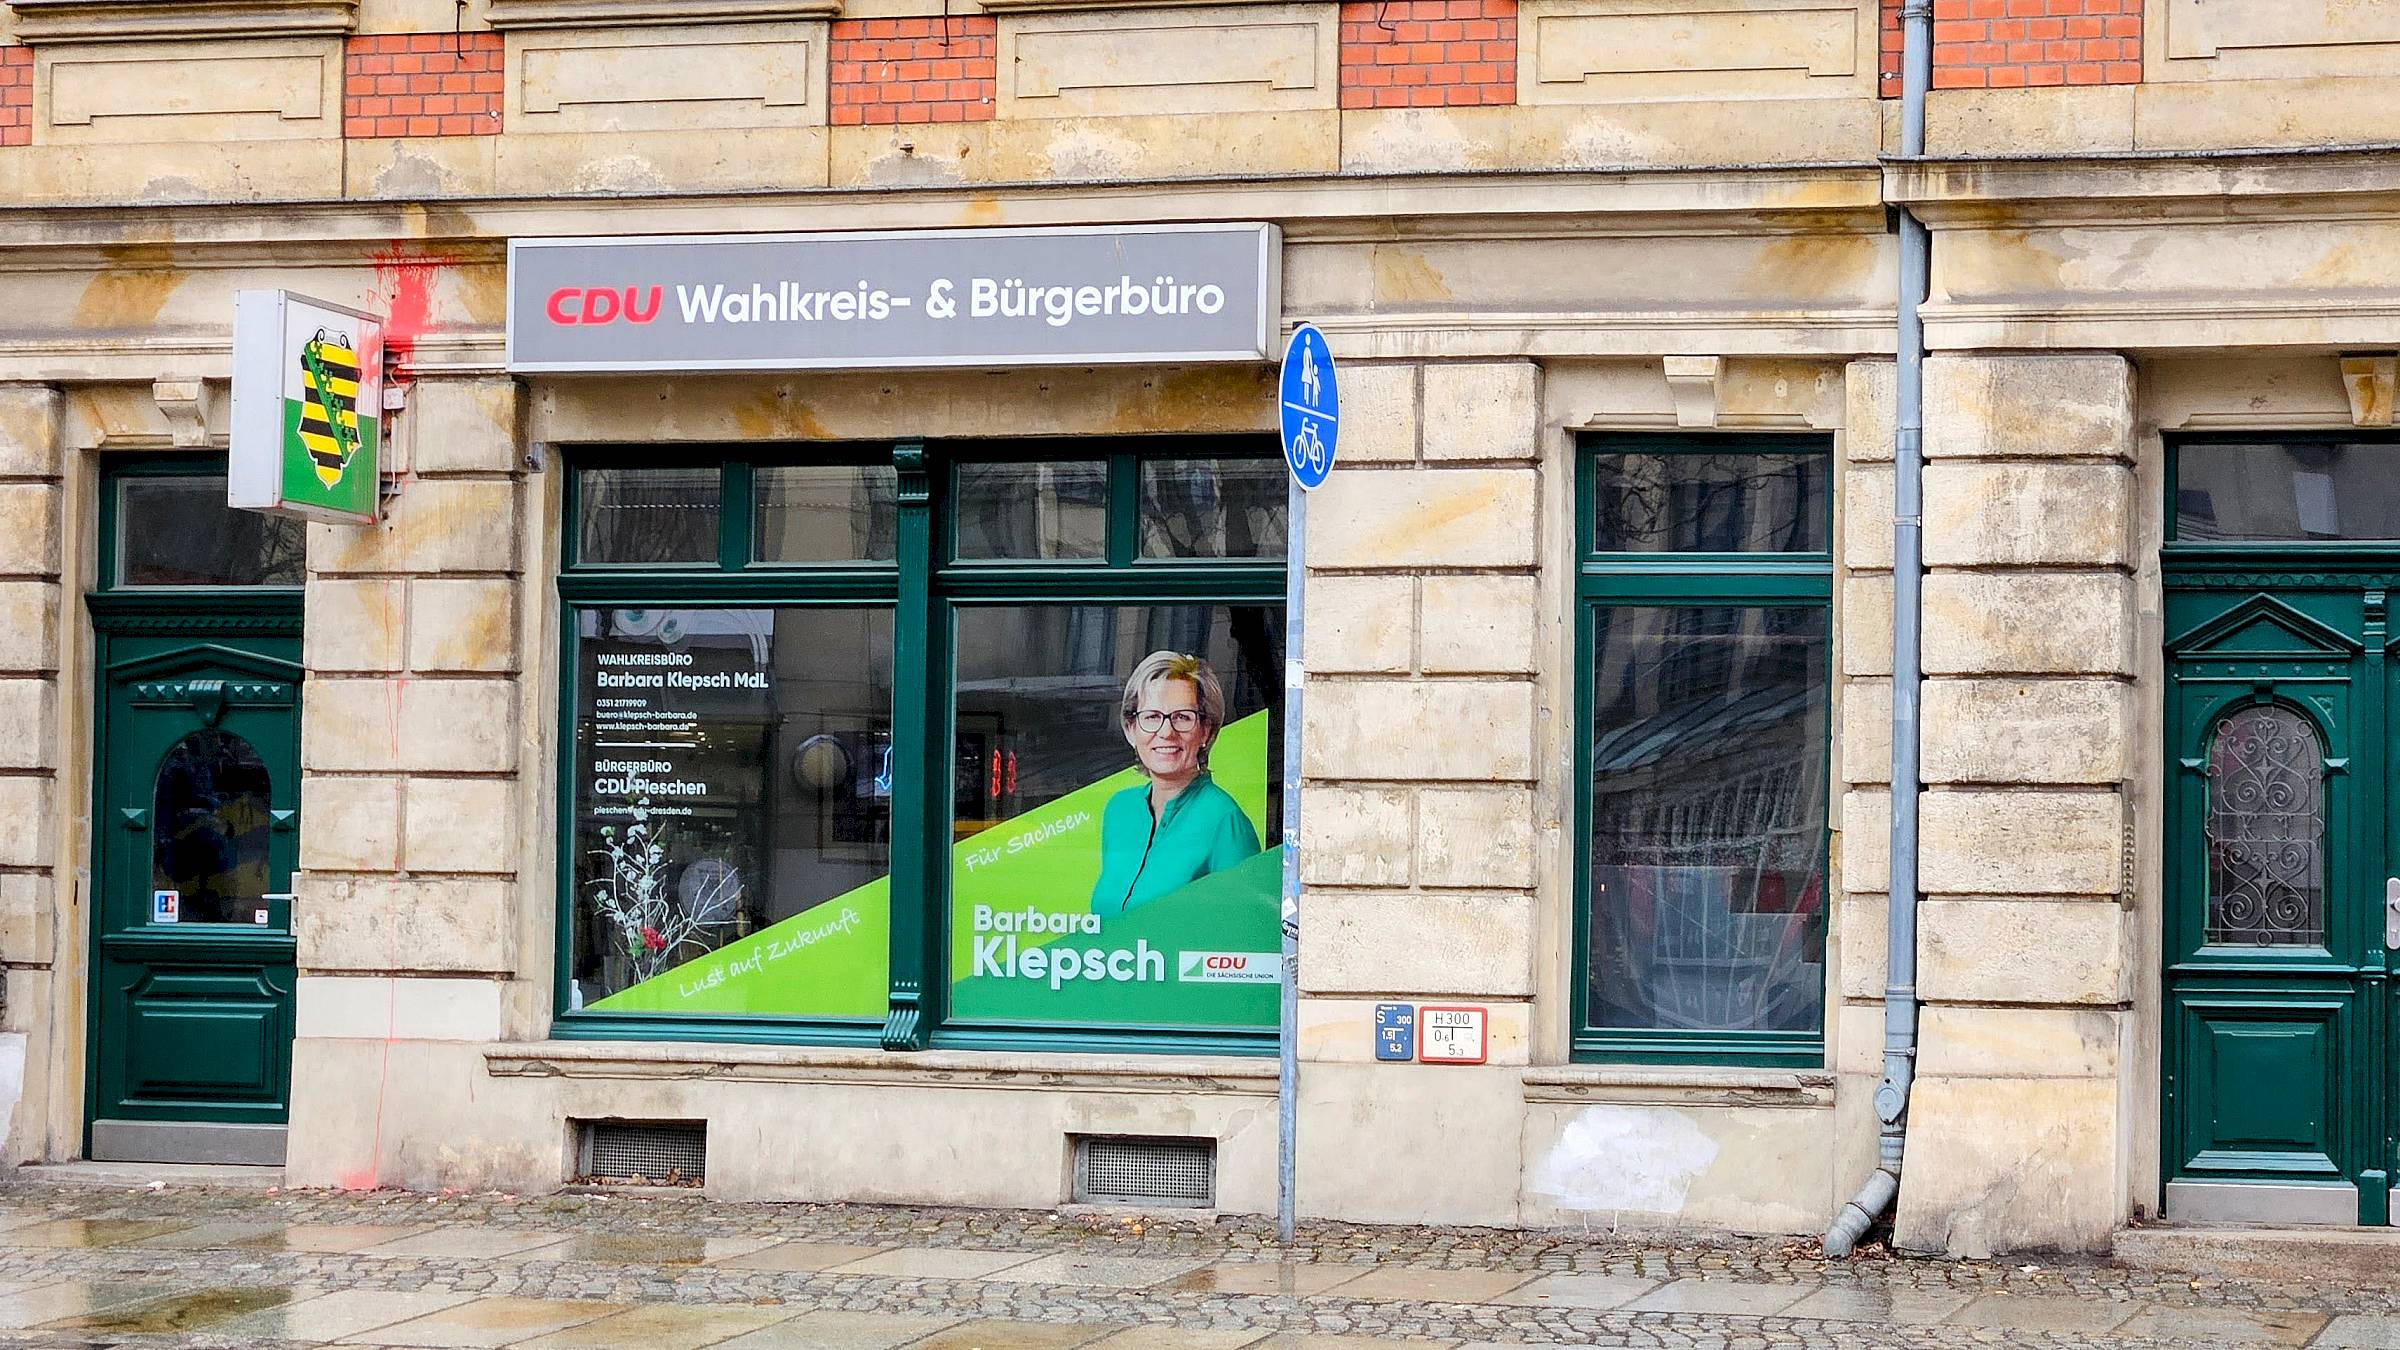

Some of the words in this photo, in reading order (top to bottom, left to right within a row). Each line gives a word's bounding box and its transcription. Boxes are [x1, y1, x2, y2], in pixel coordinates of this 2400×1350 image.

[545, 284, 664, 326] CDU
[676, 280, 911, 324] Wahlkreis-
[925, 278, 957, 320] &
[970, 275, 1225, 327] Bürgerbüro
[597, 652, 693, 666] WAHLKREISBÜRO
[597, 671, 663, 688] Barbara
[667, 671, 731, 691] Klepsch
[734, 672, 769, 688] MdL
[596, 699, 614, 708] 0351
[595, 722, 690, 732] www.klepsch-barbara.de
[594, 759, 672, 773] BÜRGERBÜRO
[594, 778, 630, 795] CDU
[635, 778, 707, 796] Pieschen
[965, 847, 1001, 872] Für
[1006, 810, 1090, 854] Sachsen
[973, 904, 1101, 934] Barbara
[679, 966, 726, 998] Lust
[729, 947, 764, 974] auf
[767, 908, 862, 961] Zukunft
[972, 934, 1165, 990] Klepsch
[1206, 956, 1247, 969] CDU
[1376, 1010, 1386, 1024] S
[1396, 1015, 1412, 1025] 300
